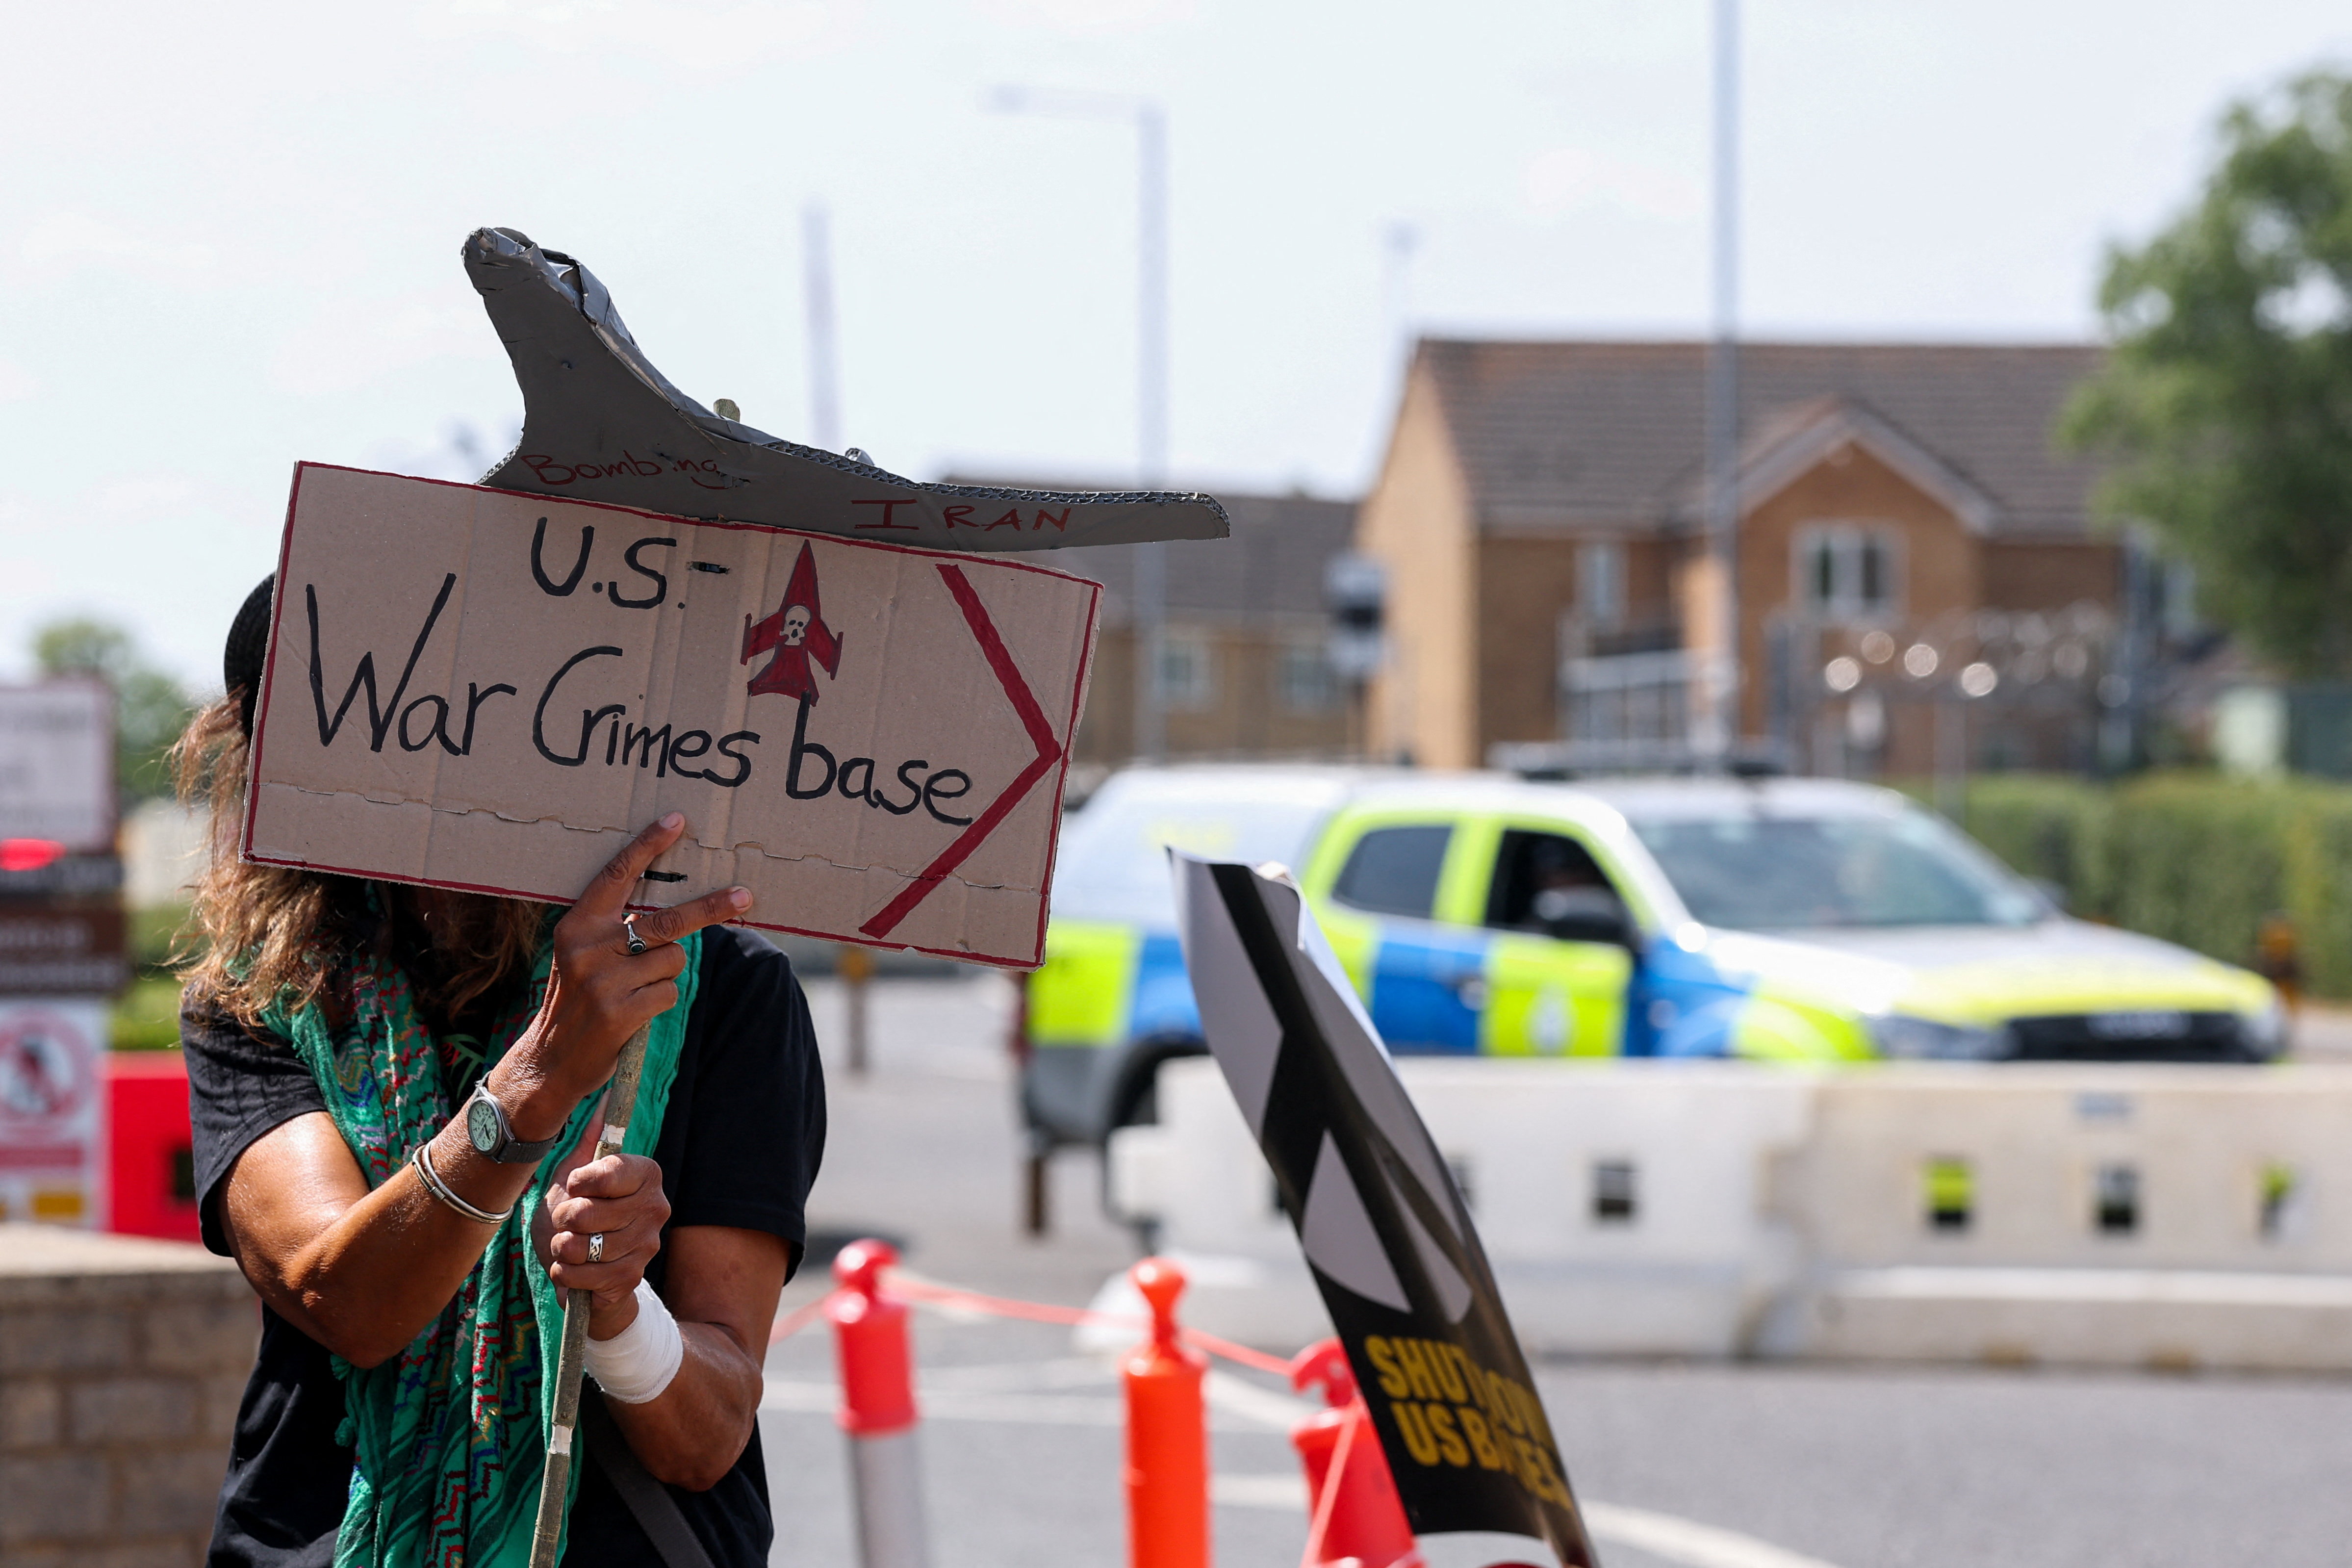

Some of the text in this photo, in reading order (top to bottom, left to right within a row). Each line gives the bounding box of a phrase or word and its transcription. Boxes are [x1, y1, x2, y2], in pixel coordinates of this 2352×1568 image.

[521, 449, 1071, 533] Bombing IRAN
[306, 572, 973, 826] War Crimes base
[1389, 1401, 1471, 1467] US
